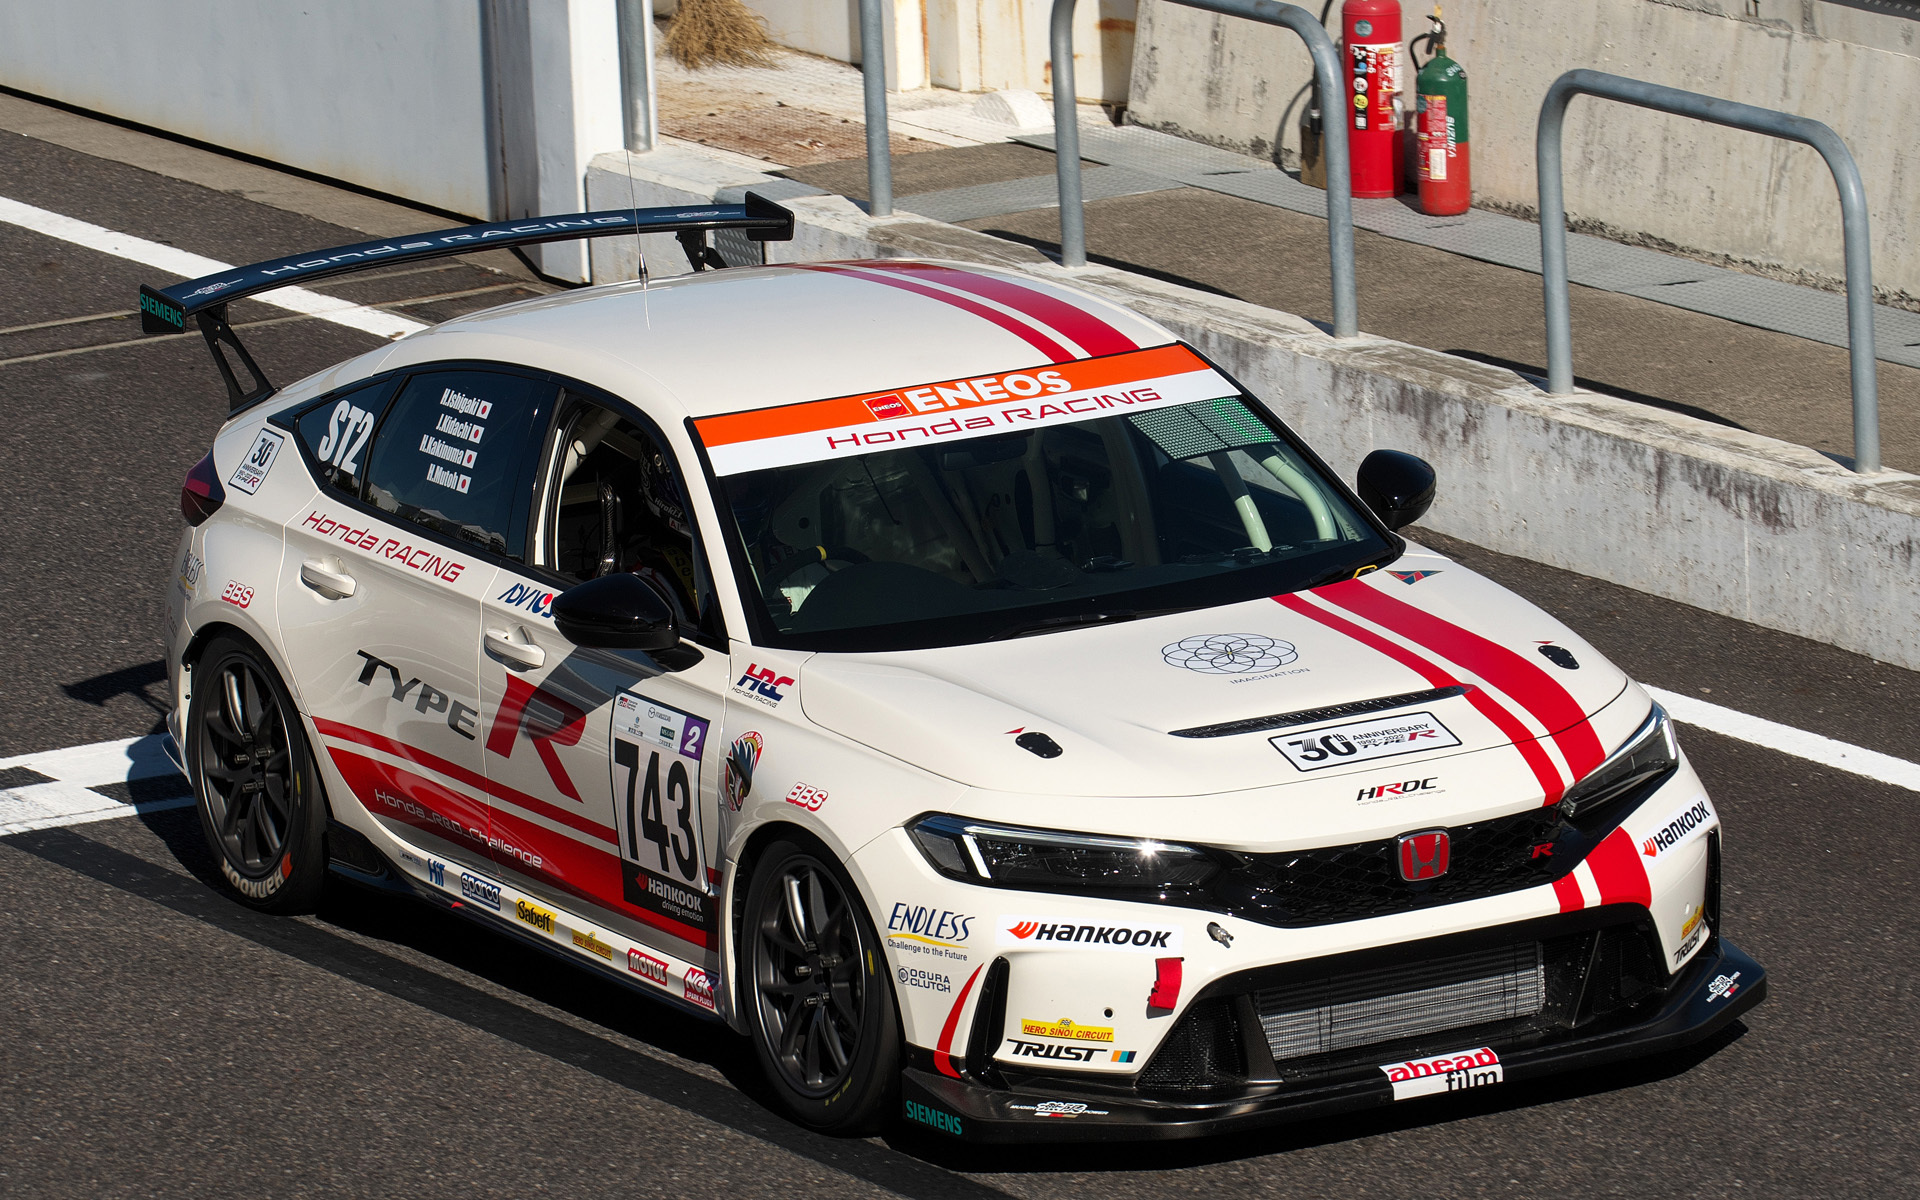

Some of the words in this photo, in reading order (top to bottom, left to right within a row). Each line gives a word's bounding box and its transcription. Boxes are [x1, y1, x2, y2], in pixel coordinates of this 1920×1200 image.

[261, 241, 433, 275] Honda
[441, 216, 627, 244] RACING
[140, 293, 183, 329] SIEMENS
[440, 388, 481, 416] H.Ishigaki
[903, 371, 1072, 413] ENEOS
[826, 415, 996, 450] Honda
[1001, 387, 1163, 424] RACING
[872, 401, 902, 413] ENEOS
[317, 399, 375, 475] ST2
[435, 413, 473, 440] J.Kidachi
[419, 433, 464, 466] H.Kakinuma
[426, 463, 459, 490] H.Mutoh
[302, 510, 380, 551] Honda
[376, 538, 465, 583] RACING
[221, 579, 254, 609] BBS
[736, 662, 795, 702] HRC
[1230, 667, 1311, 685] IMAGINATION
[731, 687, 754, 700] Honda
[753, 695, 778, 709] RACING
[356, 649, 479, 741] TYPE
[486, 672, 586, 804] R
[684, 725, 701, 754] 2
[1352, 722, 1430, 741] ANNIVERSARY
[1408, 729, 1440, 742] R
[785, 781, 829, 811] BBS
[1356, 776, 1439, 801] HRDC
[614, 738, 698, 882] 743
[1531, 842, 1554, 859] R
[461, 874, 500, 903] sparco
[517, 900, 551, 933] Sabelt
[662, 900, 681, 915] driving
[681, 906, 704, 923] emotion
[888, 901, 975, 942] ENDLESS
[887, 938, 921, 953] Challenge
[923, 945, 930, 954] to
[932, 948, 943, 957] the
[945, 949, 968, 961] Future
[629, 952, 666, 982] MOTUL
[910, 968, 950, 985] OGURA
[685, 970, 712, 998] NGK
[910, 977, 951, 994] CLUTCH
[1023, 1024, 1047, 1036] HERO
[1075, 1029, 1113, 1041] CIRCUIT
[1006, 1038, 1107, 1062] TRUST
[1387, 1047, 1498, 1082] ahead
[1446, 1069, 1498, 1092] film
[905, 1100, 963, 1135] SIEMENS
